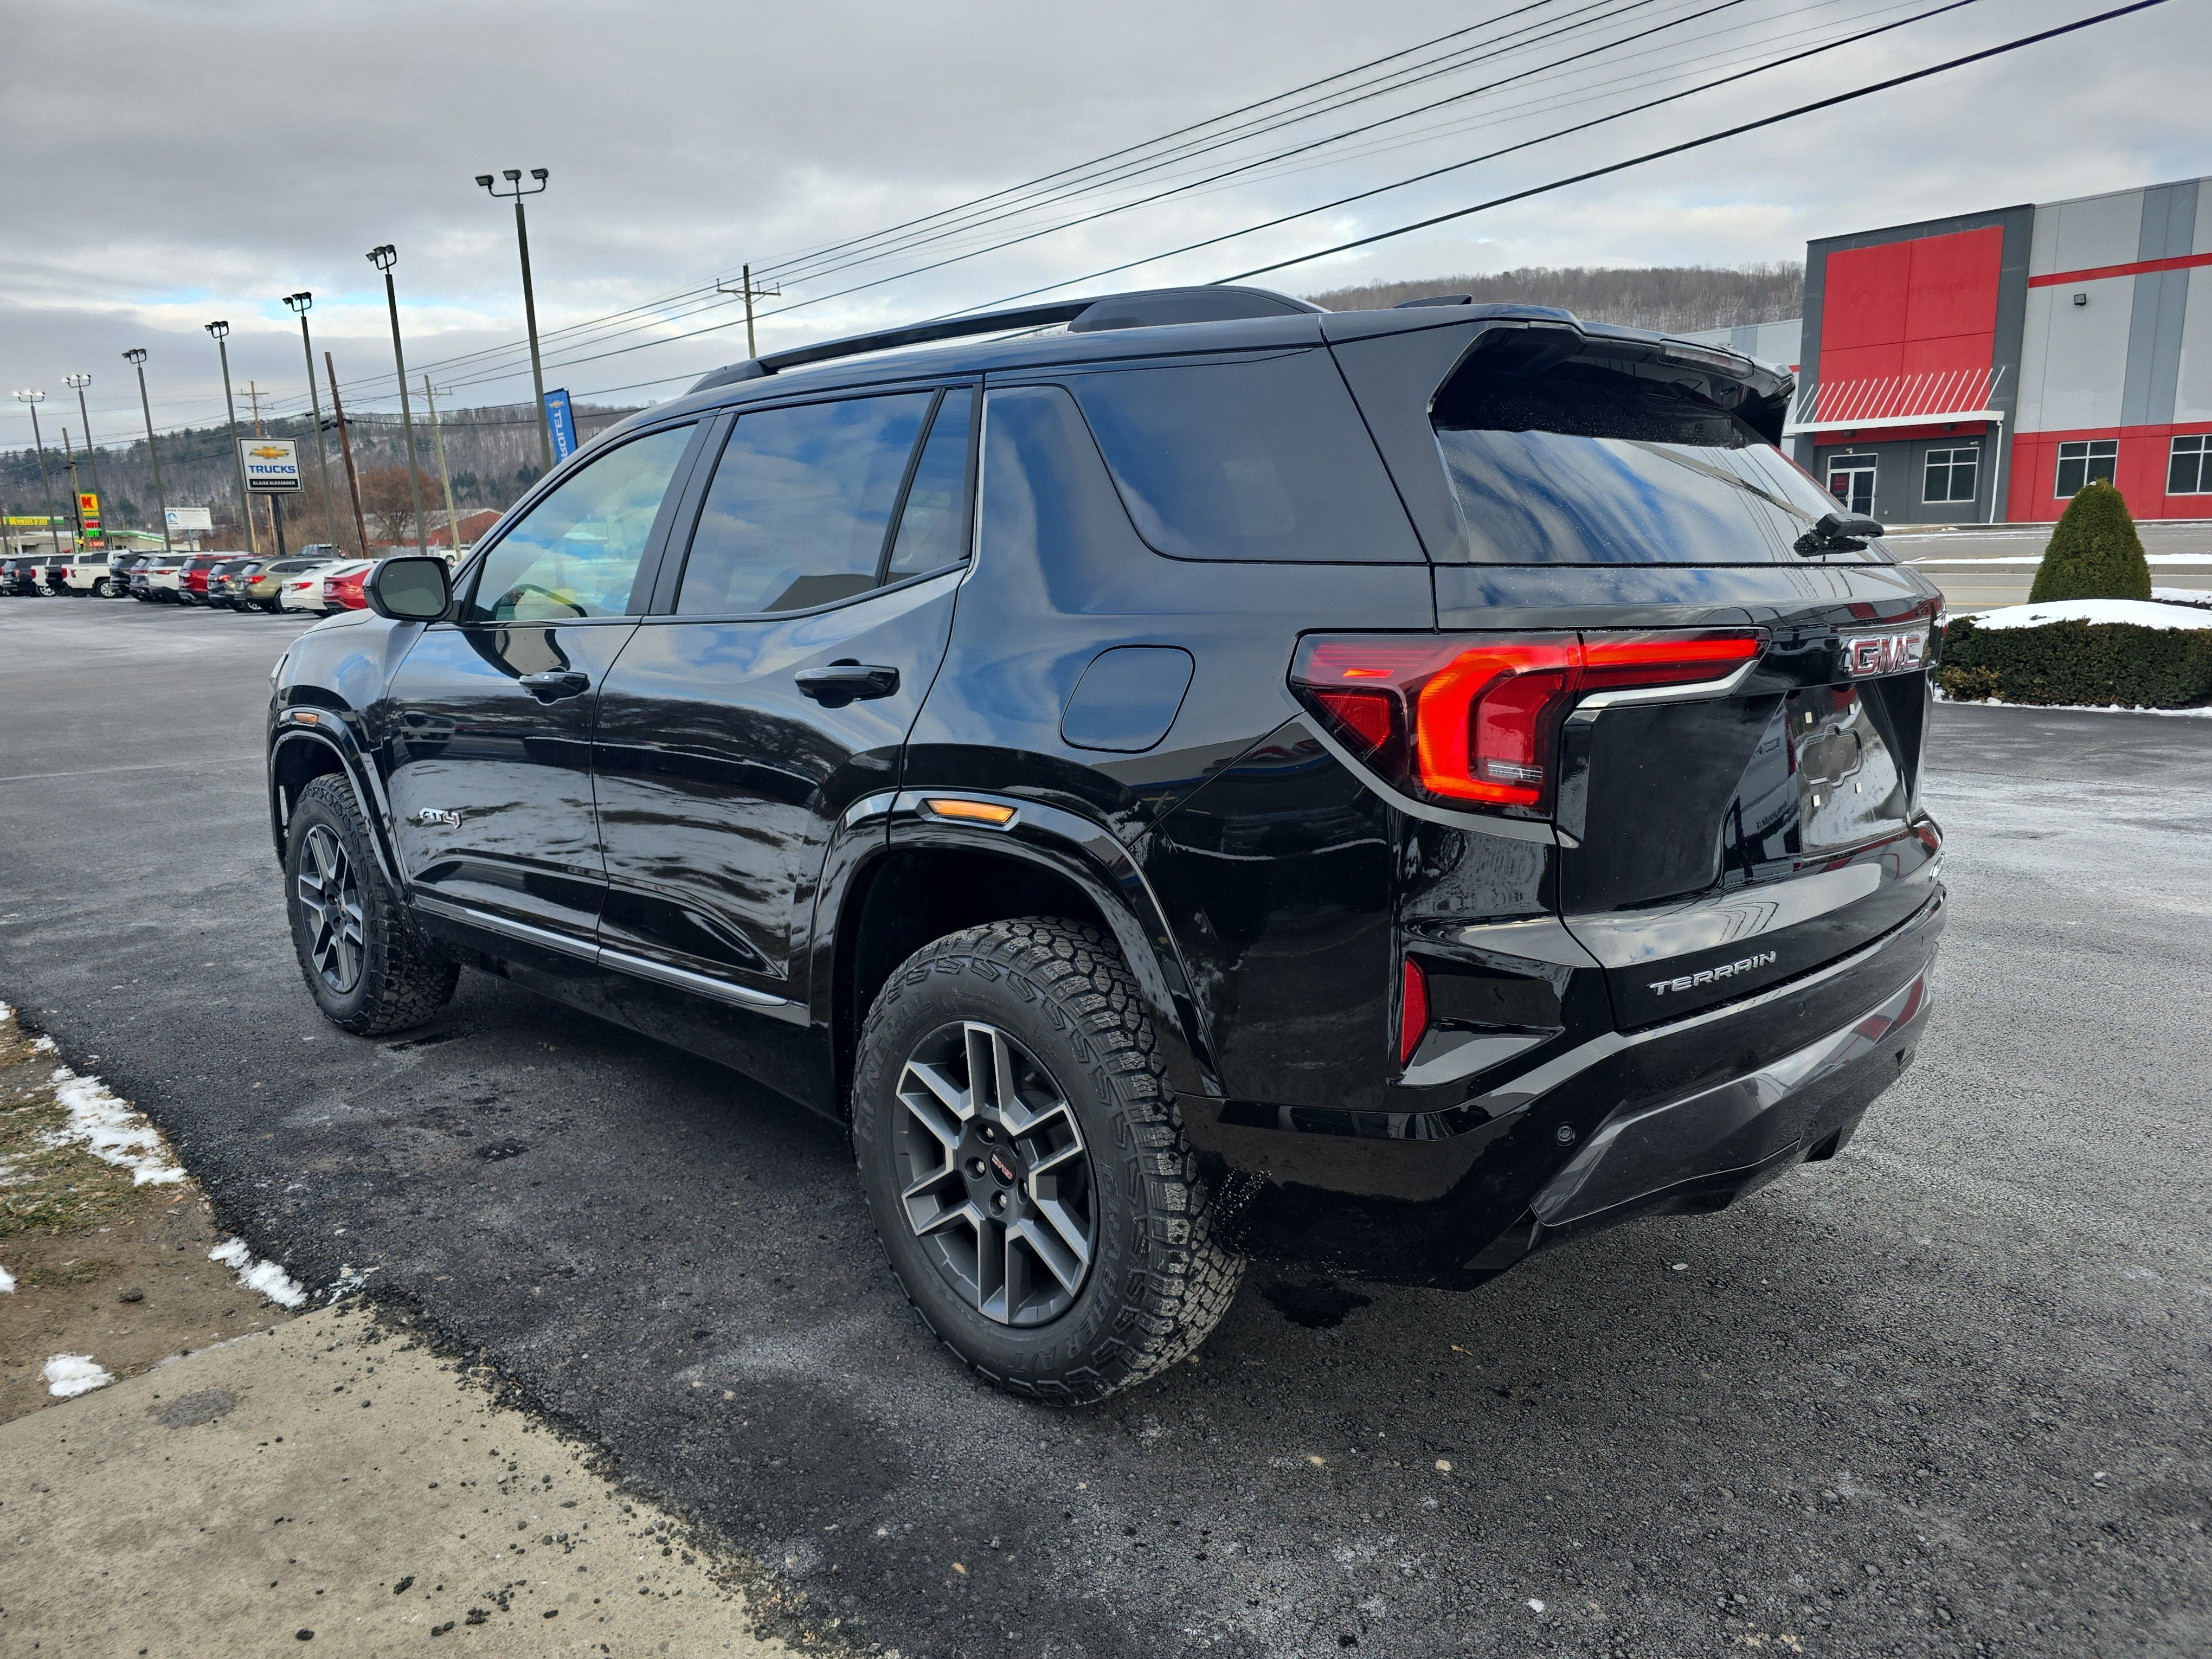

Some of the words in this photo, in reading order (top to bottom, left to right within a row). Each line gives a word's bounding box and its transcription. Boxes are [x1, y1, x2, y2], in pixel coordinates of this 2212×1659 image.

[248, 465, 295, 473] TRUCKS
[81, 497, 94, 509] K
[1849, 635, 1920, 677] GMC
[1647, 950, 1777, 996] TERRAIN
[860, 992, 933, 1144] GENERAL
[1064, 1161, 1122, 1360] GRABBER
